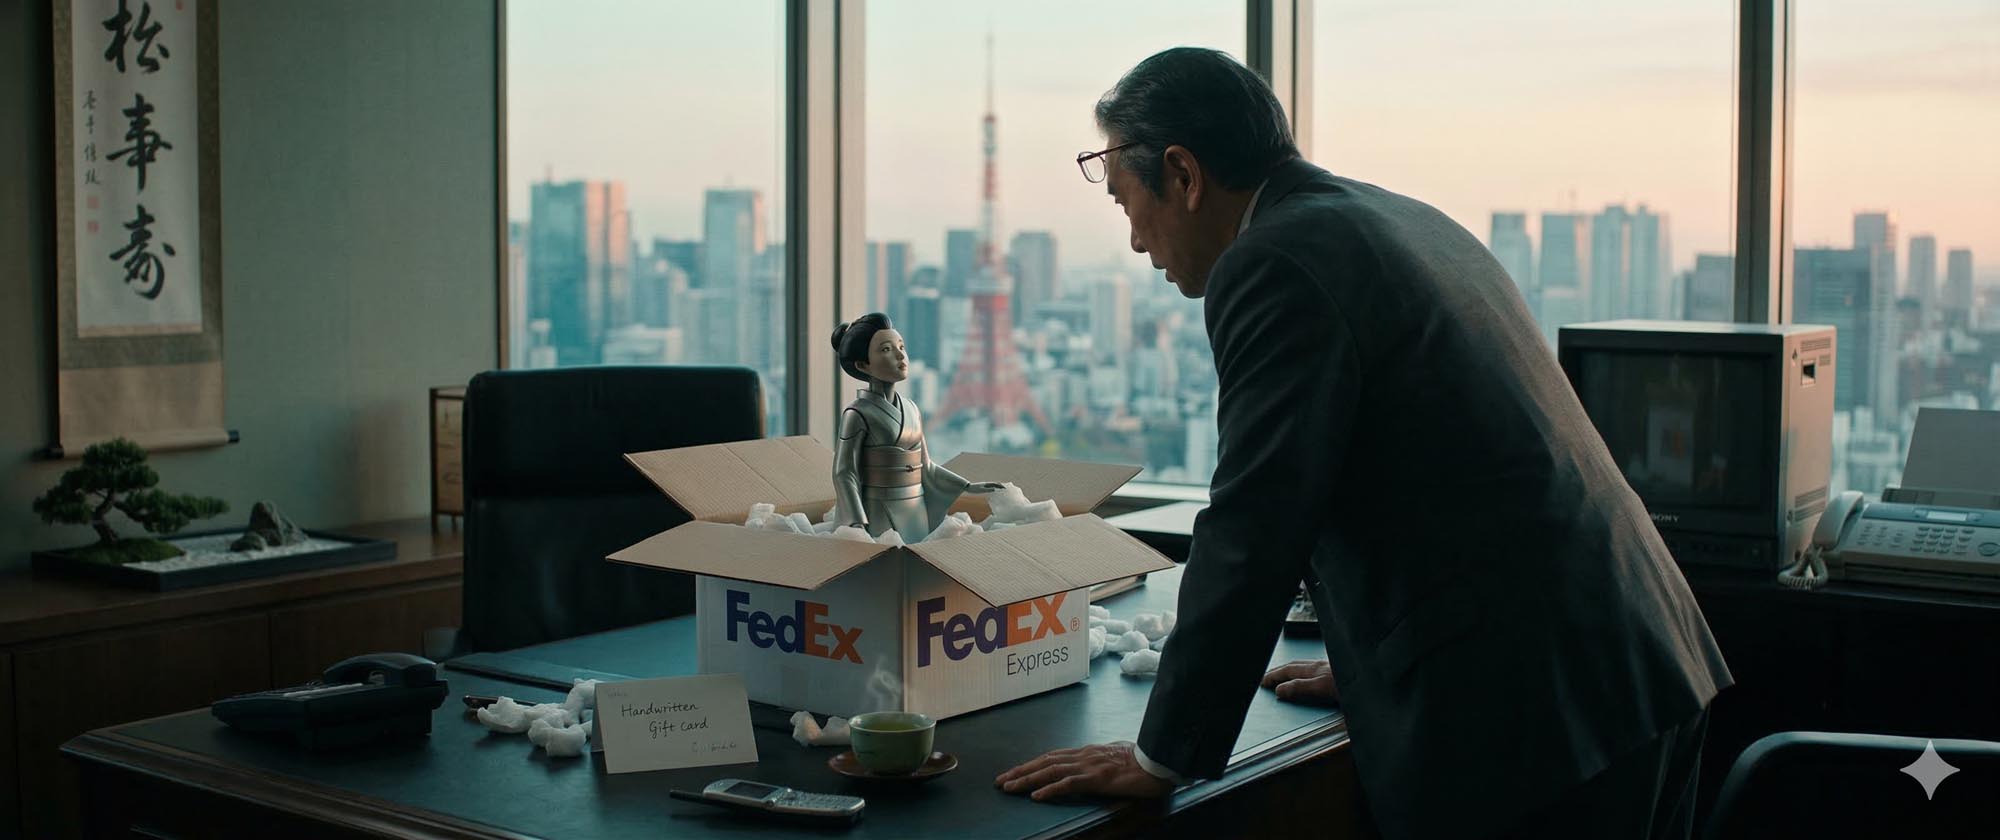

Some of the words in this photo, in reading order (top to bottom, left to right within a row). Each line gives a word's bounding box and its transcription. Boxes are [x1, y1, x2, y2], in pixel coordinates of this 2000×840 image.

[727, 589, 864, 665] FedEx
[1007, 646, 1069, 676] Express
[621, 702, 699, 718] Handwritten
[649, 721, 675, 739] Gift
